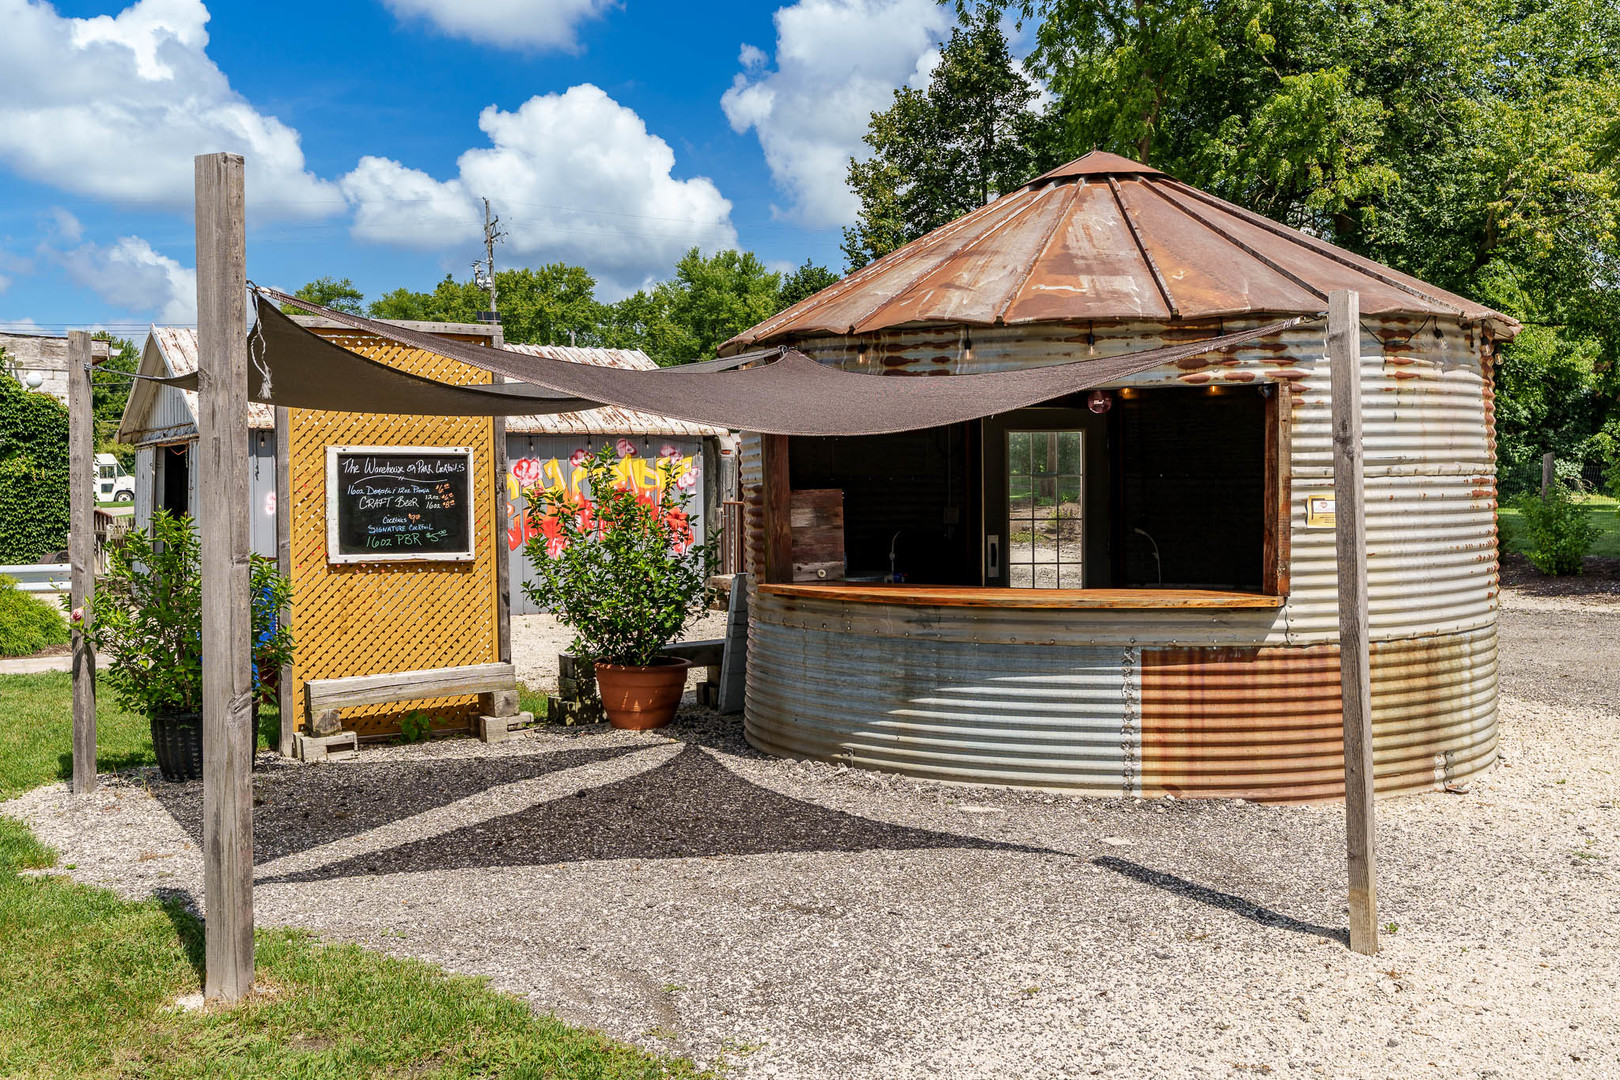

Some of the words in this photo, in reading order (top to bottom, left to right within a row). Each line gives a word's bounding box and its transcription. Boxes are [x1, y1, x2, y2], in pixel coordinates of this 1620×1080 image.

[342, 458, 360, 473] The
[359, 496, 394, 510] CRAFT
[395, 532, 422, 547] PBR
